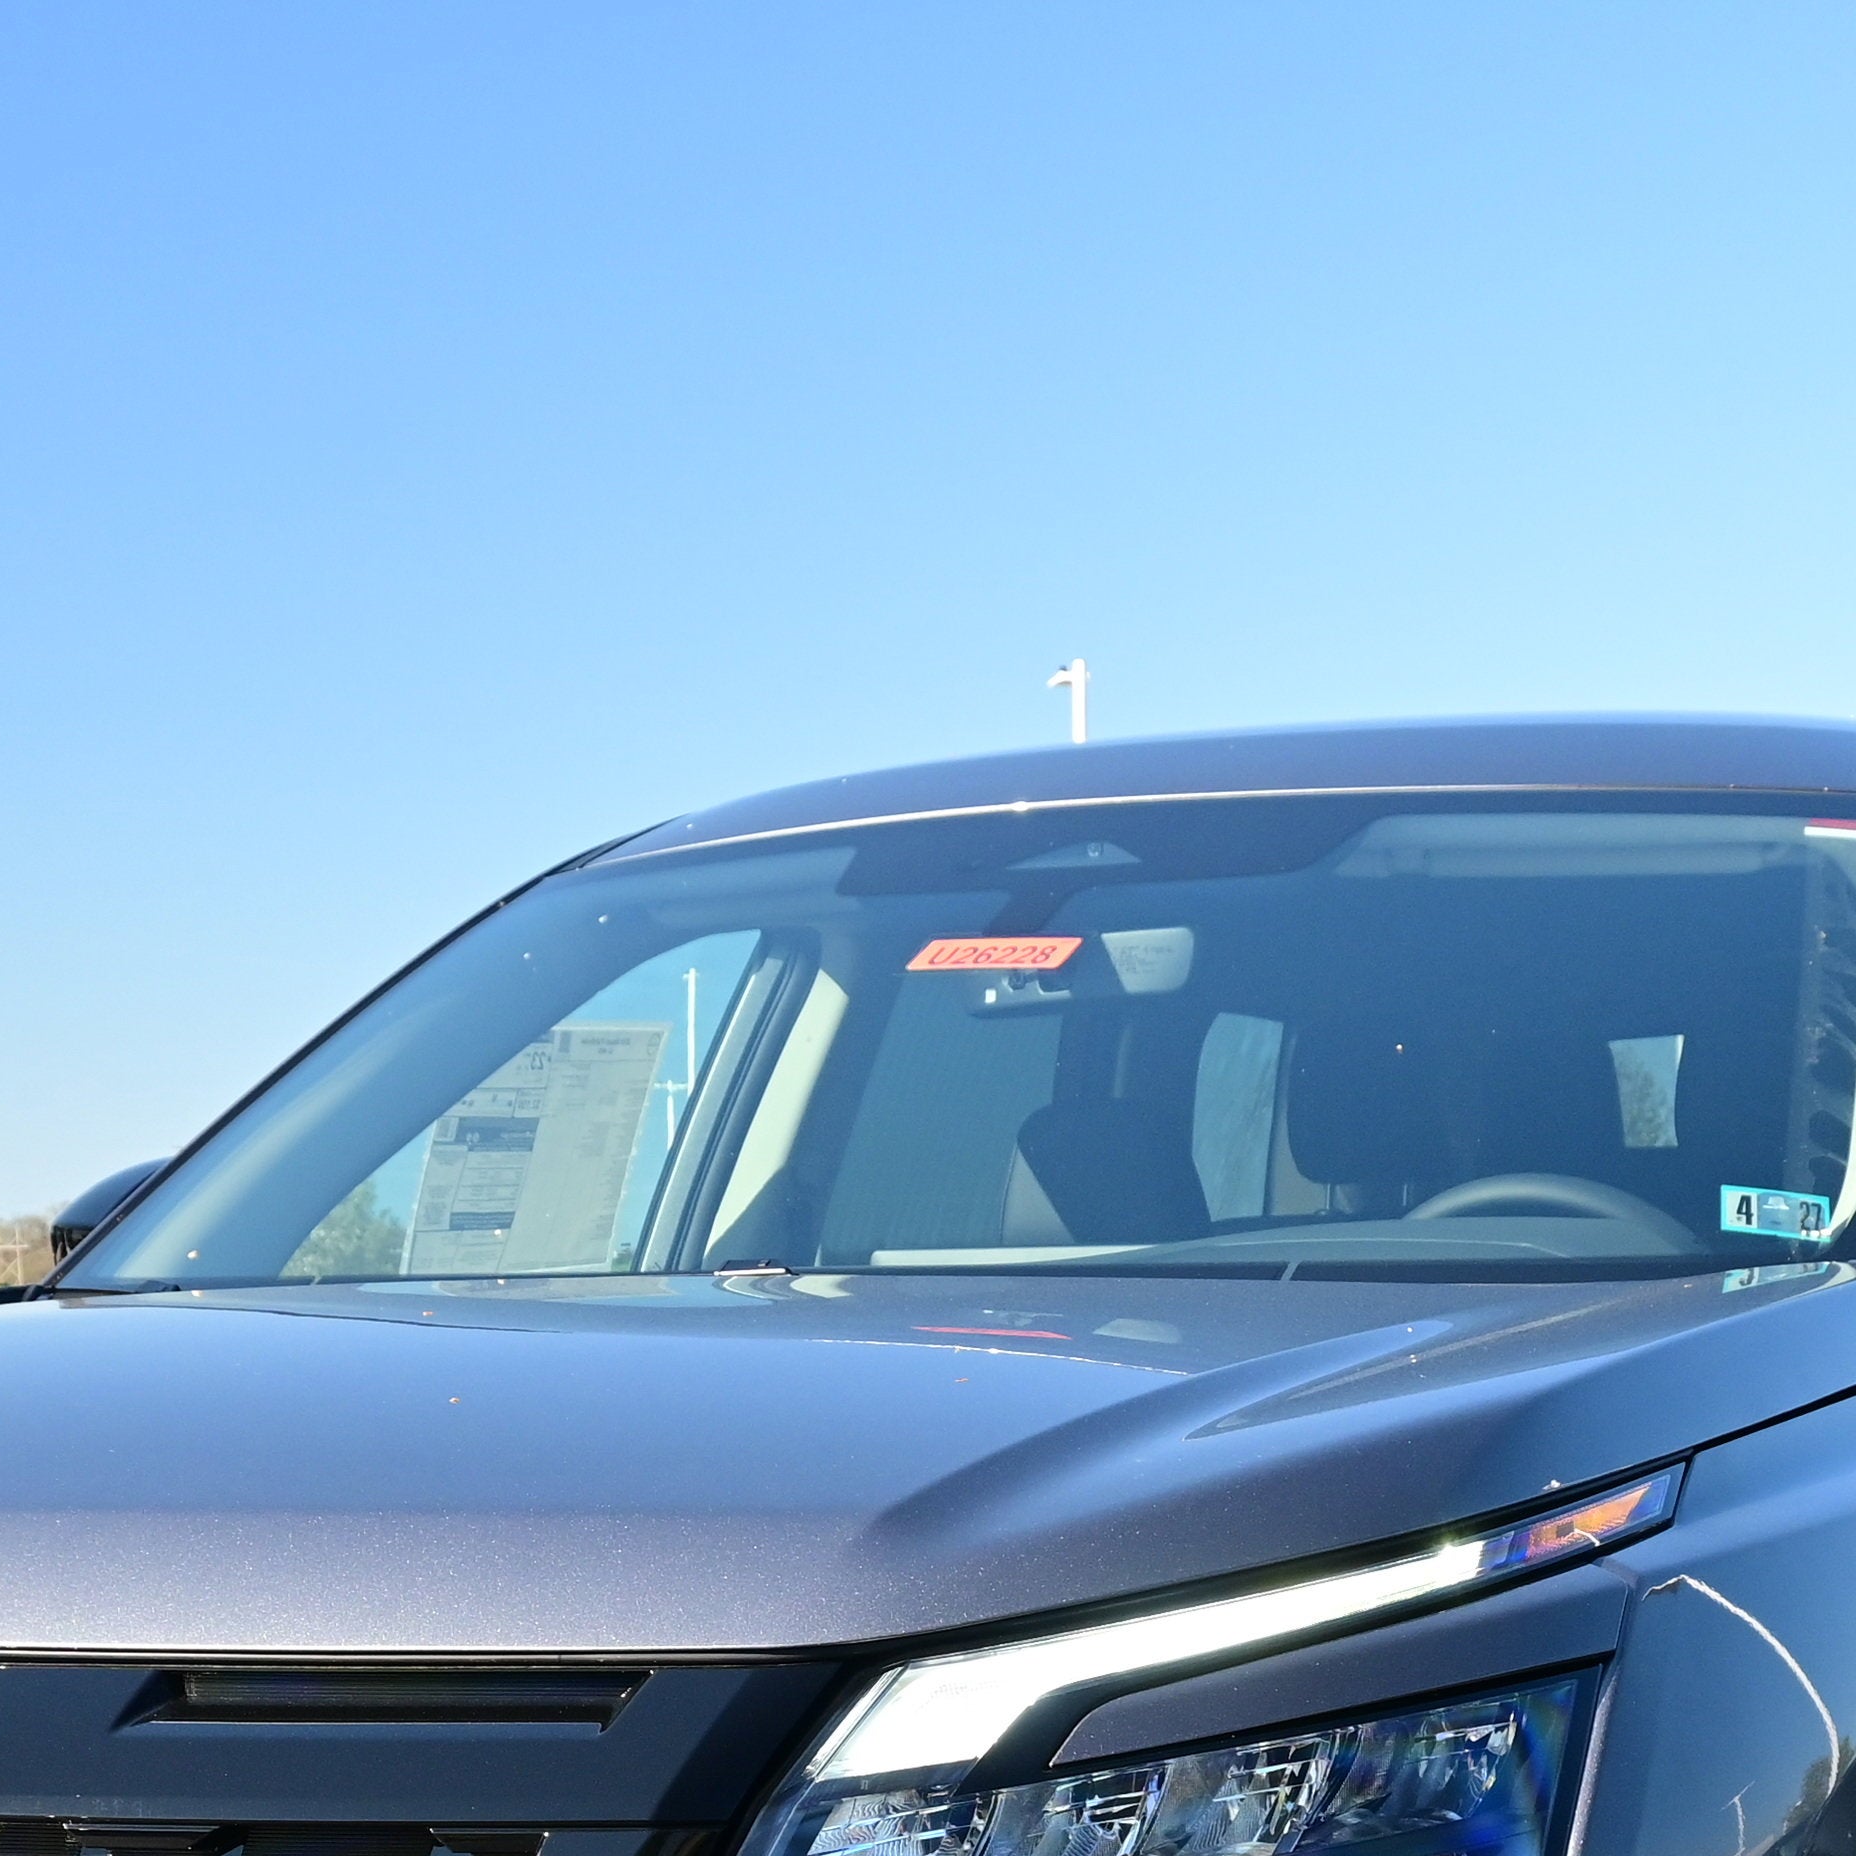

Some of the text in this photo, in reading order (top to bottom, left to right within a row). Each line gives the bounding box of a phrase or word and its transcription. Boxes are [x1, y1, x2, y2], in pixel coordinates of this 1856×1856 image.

[928, 945, 1057, 965] U26228
[1736, 1194, 1822, 1232] 4 27
